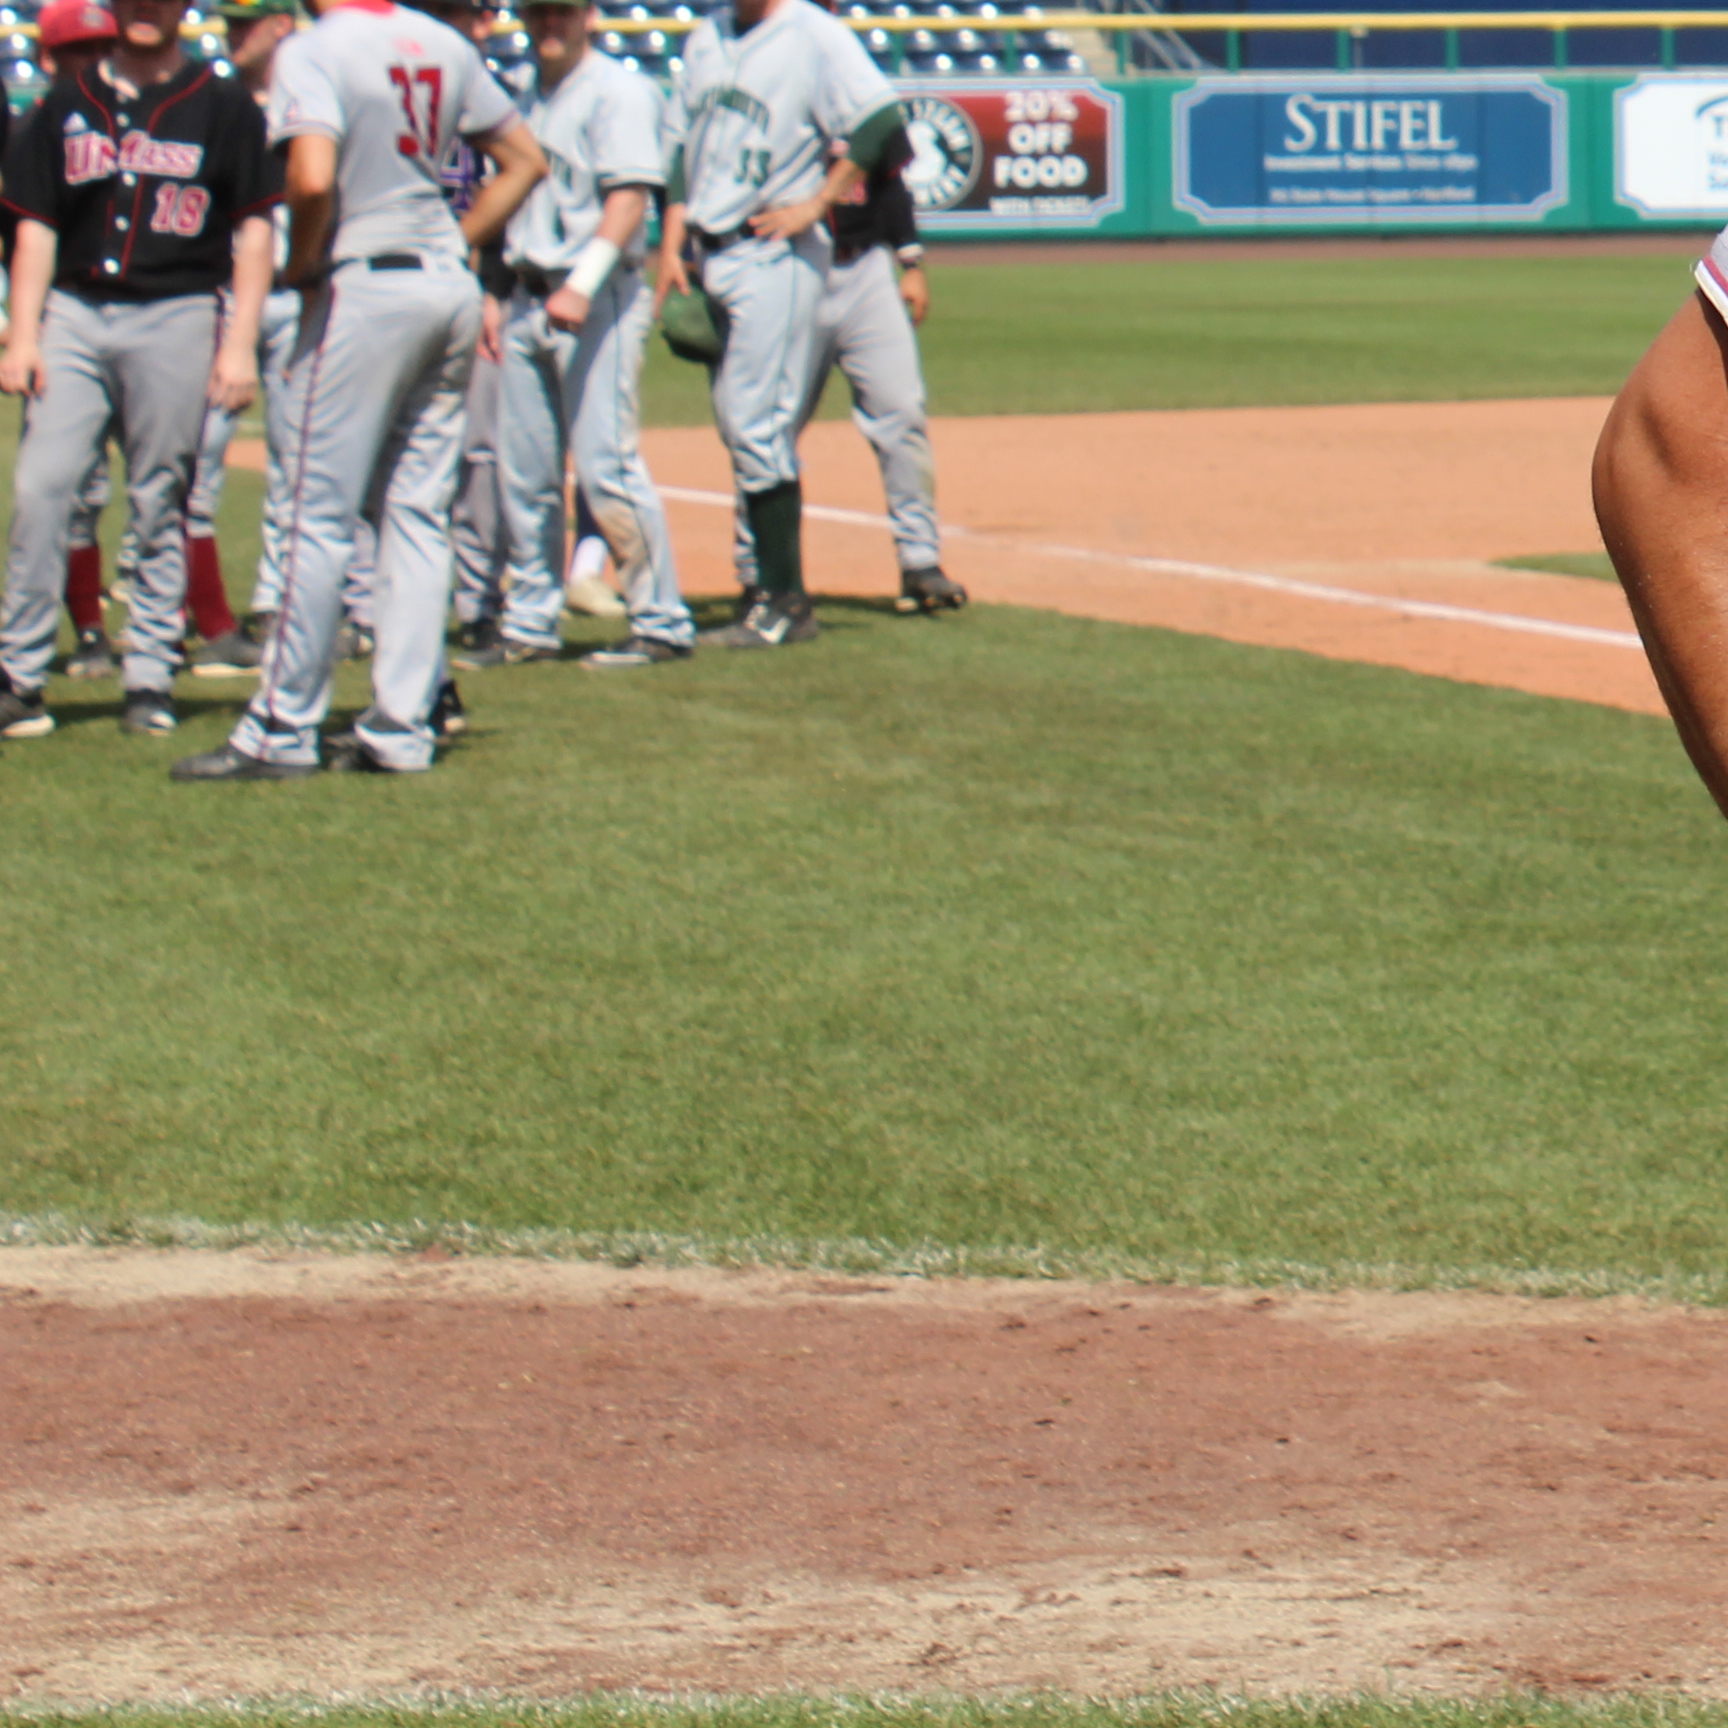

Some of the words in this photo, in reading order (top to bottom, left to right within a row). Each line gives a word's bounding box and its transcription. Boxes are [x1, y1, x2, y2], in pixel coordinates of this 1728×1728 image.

[1004, 90, 1079, 122] 20%
[1284, 92, 1458, 152] STIFEL
[1008, 123, 1073, 155] OFF
[994, 154, 1088, 188] FOOD
